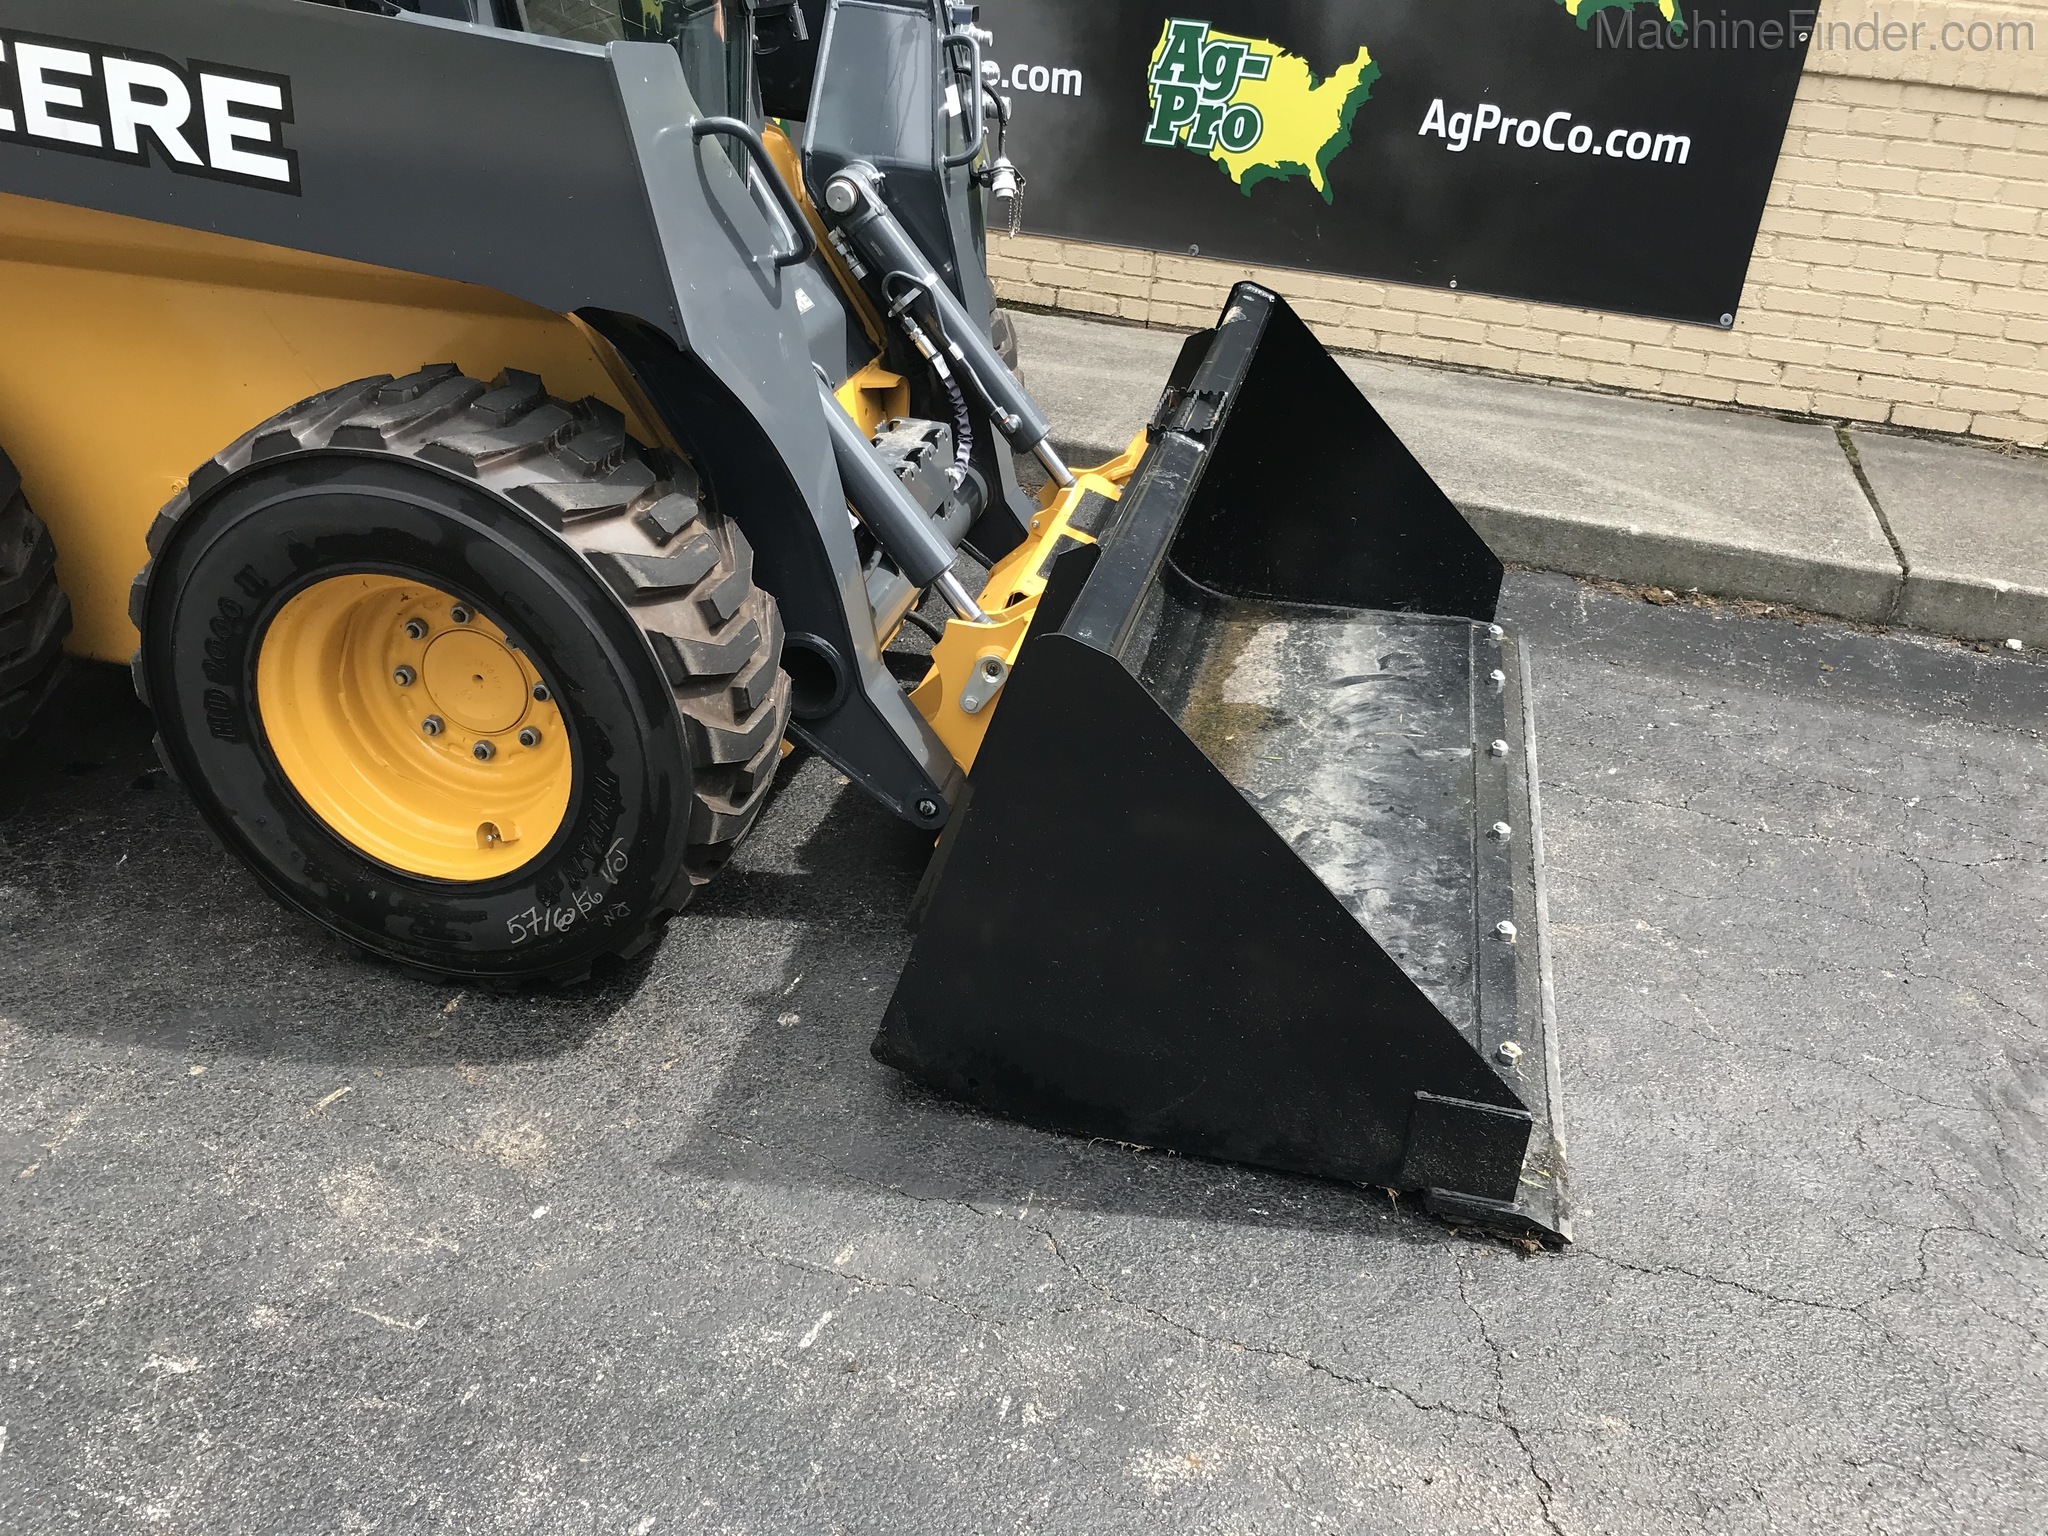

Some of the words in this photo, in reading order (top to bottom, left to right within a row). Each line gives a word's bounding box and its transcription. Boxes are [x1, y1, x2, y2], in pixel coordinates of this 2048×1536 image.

[1149, 18, 1273, 103] Ag-
[1143, 82, 1264, 153] Pro
[1418, 98, 1692, 165] AgProCo.com
